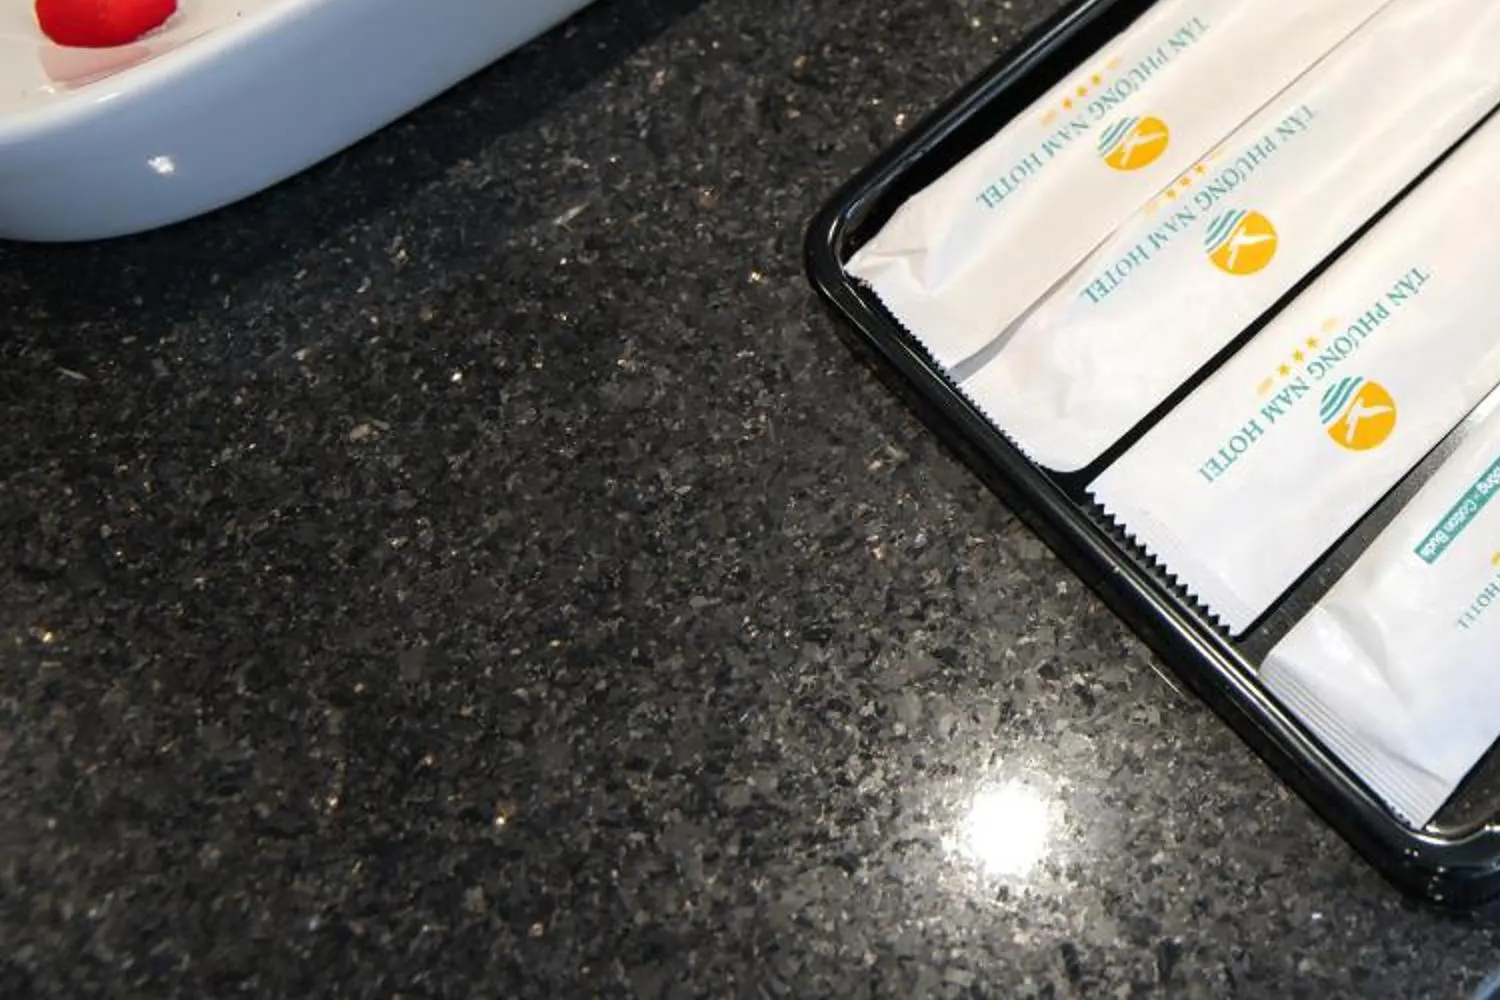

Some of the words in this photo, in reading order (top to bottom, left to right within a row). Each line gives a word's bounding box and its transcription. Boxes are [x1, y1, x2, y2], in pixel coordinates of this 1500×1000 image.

[1041, 115, 1087, 157] NAM
[975, 152, 1043, 211] HOTEL
[1147, 205, 1196, 250] NAM
[1080, 244, 1149, 307] HOTEL
[1385, 263, 1431, 309] TÂN
[1260, 376, 1309, 424] NAM
